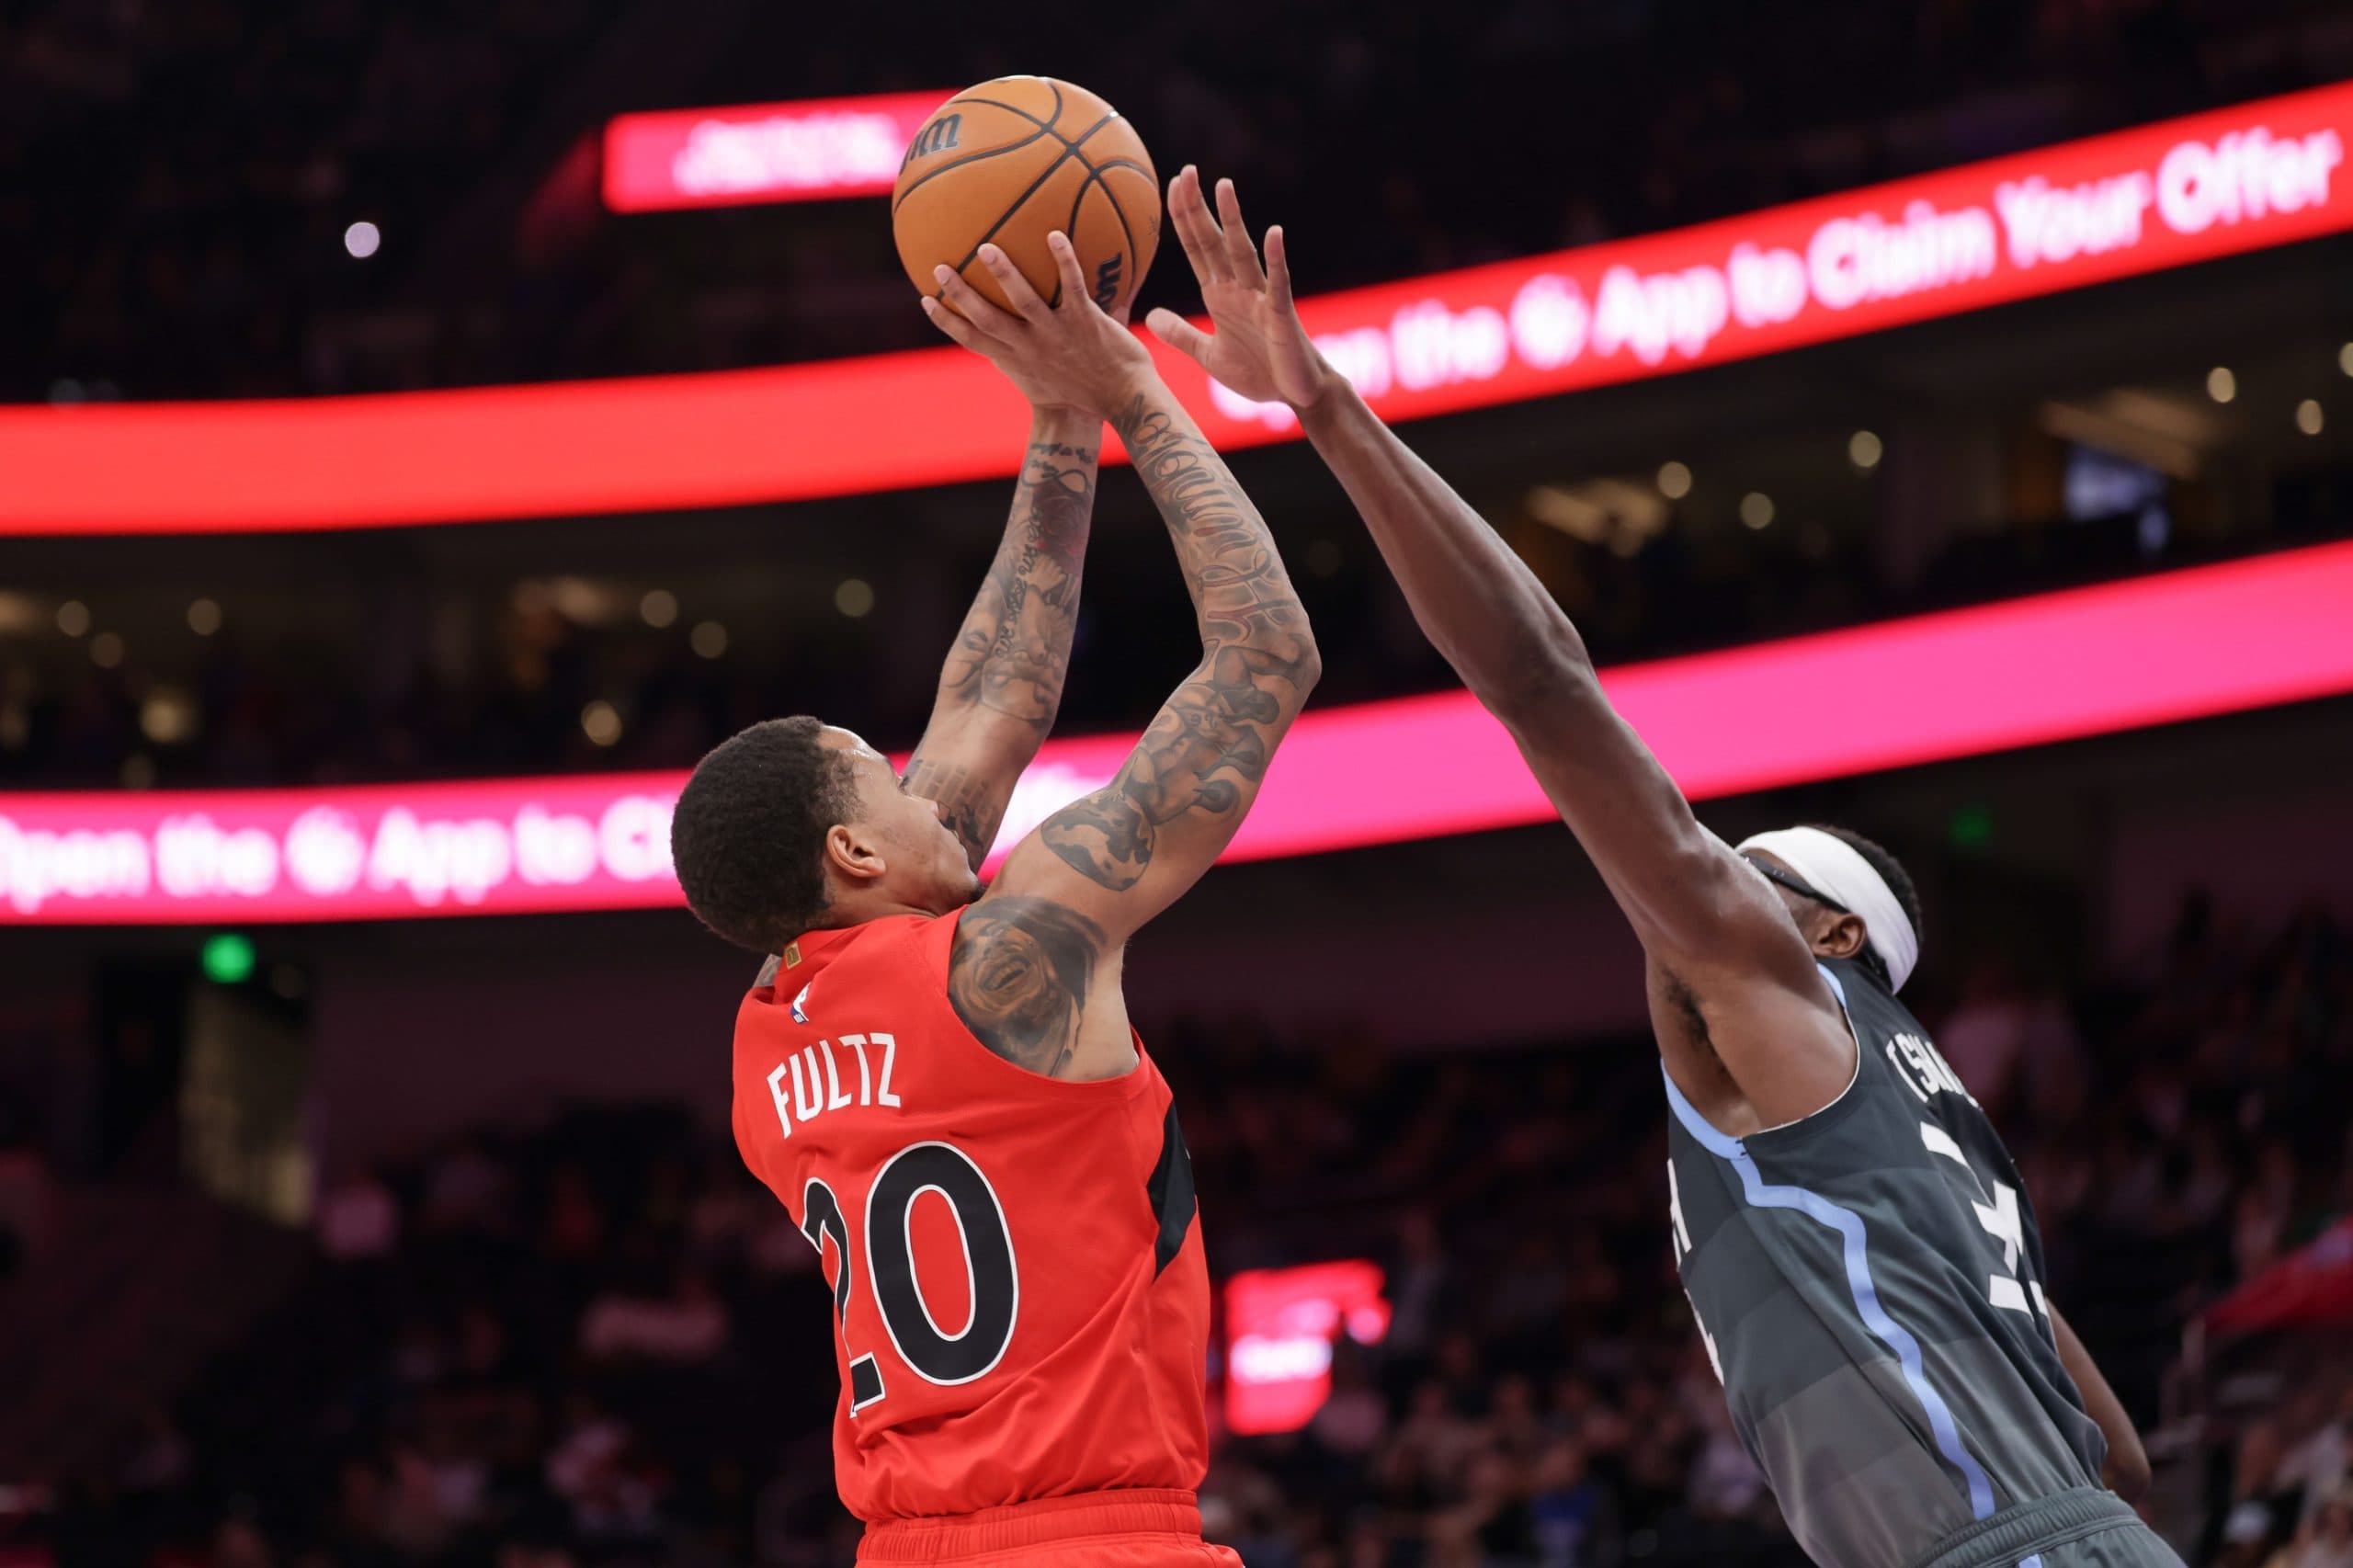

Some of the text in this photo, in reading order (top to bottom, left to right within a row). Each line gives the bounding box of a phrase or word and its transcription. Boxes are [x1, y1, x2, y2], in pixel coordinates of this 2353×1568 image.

[1389, 301, 1509, 389] the
[1591, 265, 1727, 364] App
[1729, 242, 1808, 326] to
[1808, 199, 1996, 309] Claim
[1994, 176, 2152, 268] Your
[2156, 127, 2341, 233] Offer
[153, 814, 279, 896] the
[370, 808, 510, 904] App
[512, 802, 597, 884] to
[767, 1033, 901, 1139] FULTZ
